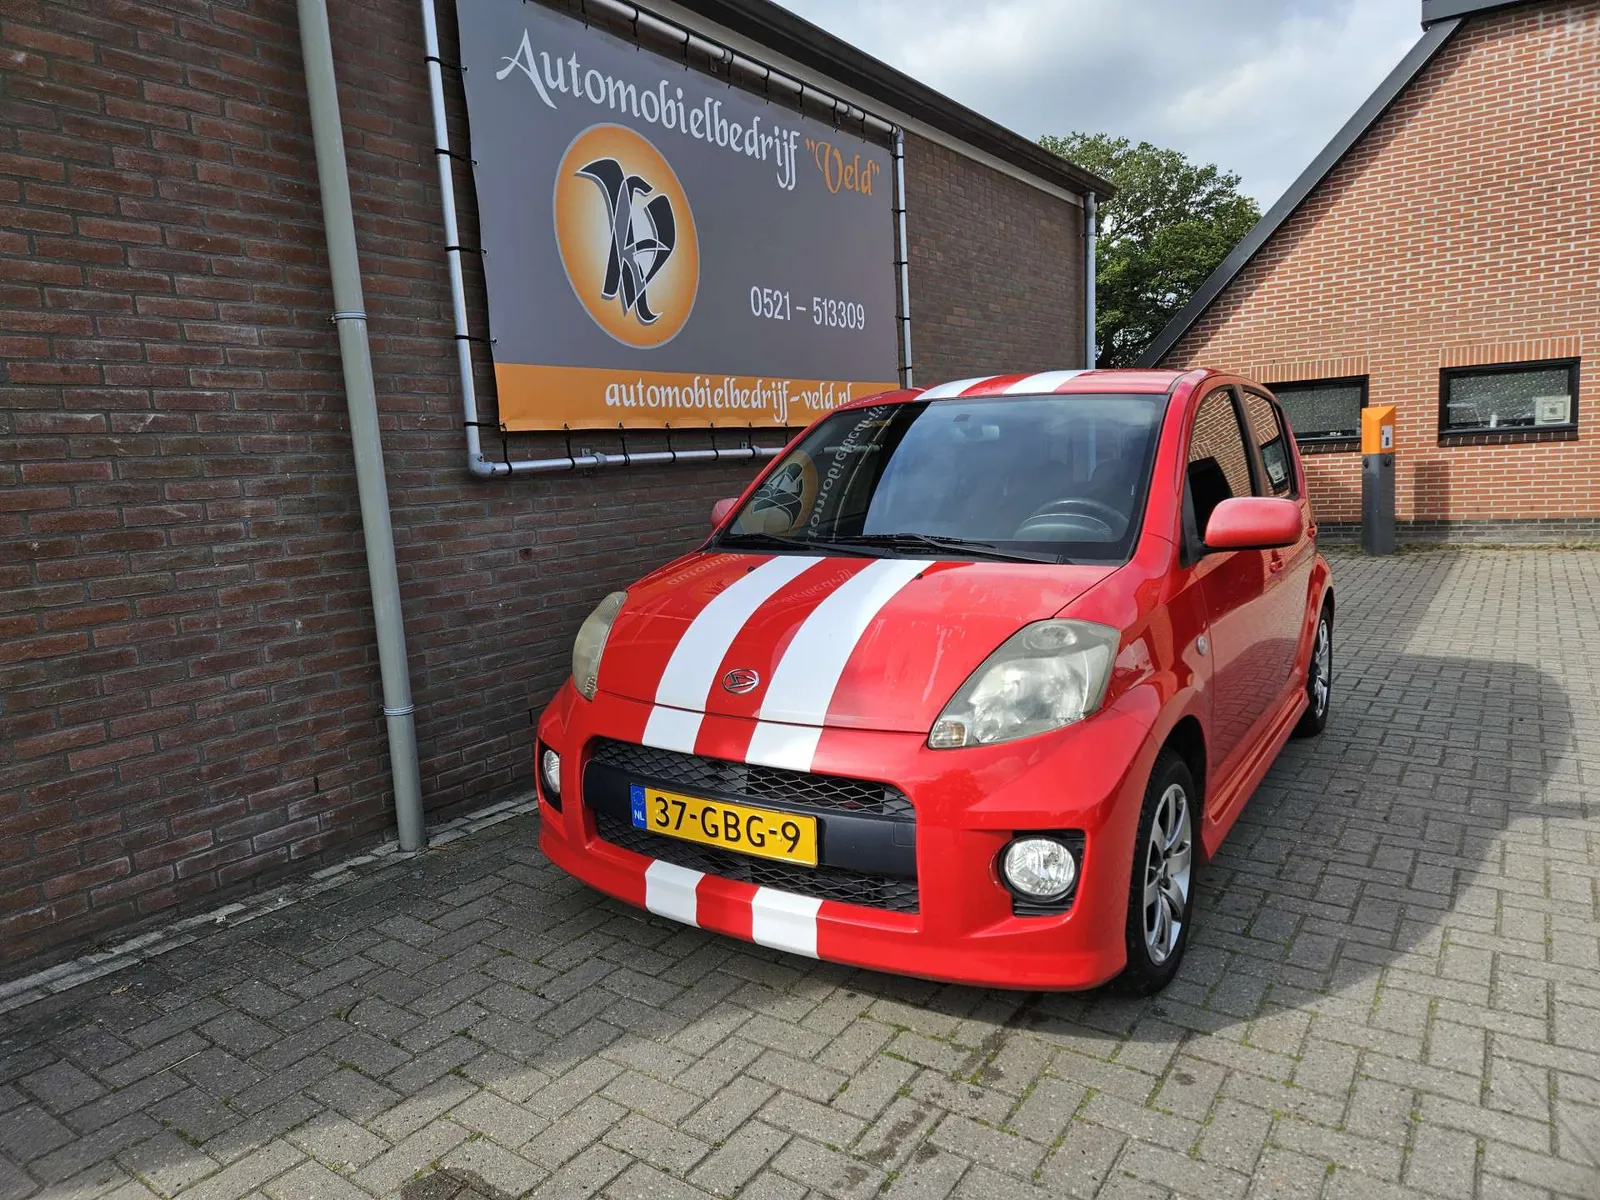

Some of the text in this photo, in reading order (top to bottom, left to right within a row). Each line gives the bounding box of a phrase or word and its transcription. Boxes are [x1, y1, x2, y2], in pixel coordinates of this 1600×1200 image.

[496, 28, 800, 190] Automobielbedrijf
[750, 286, 791, 321] 0521
[812, 296, 865, 330] 513309
[605, 376, 853, 424] automobielbedrijf-veld.nl
[634, 809, 646, 821] NL
[655, 796, 801, 853] 37-GBG-9
